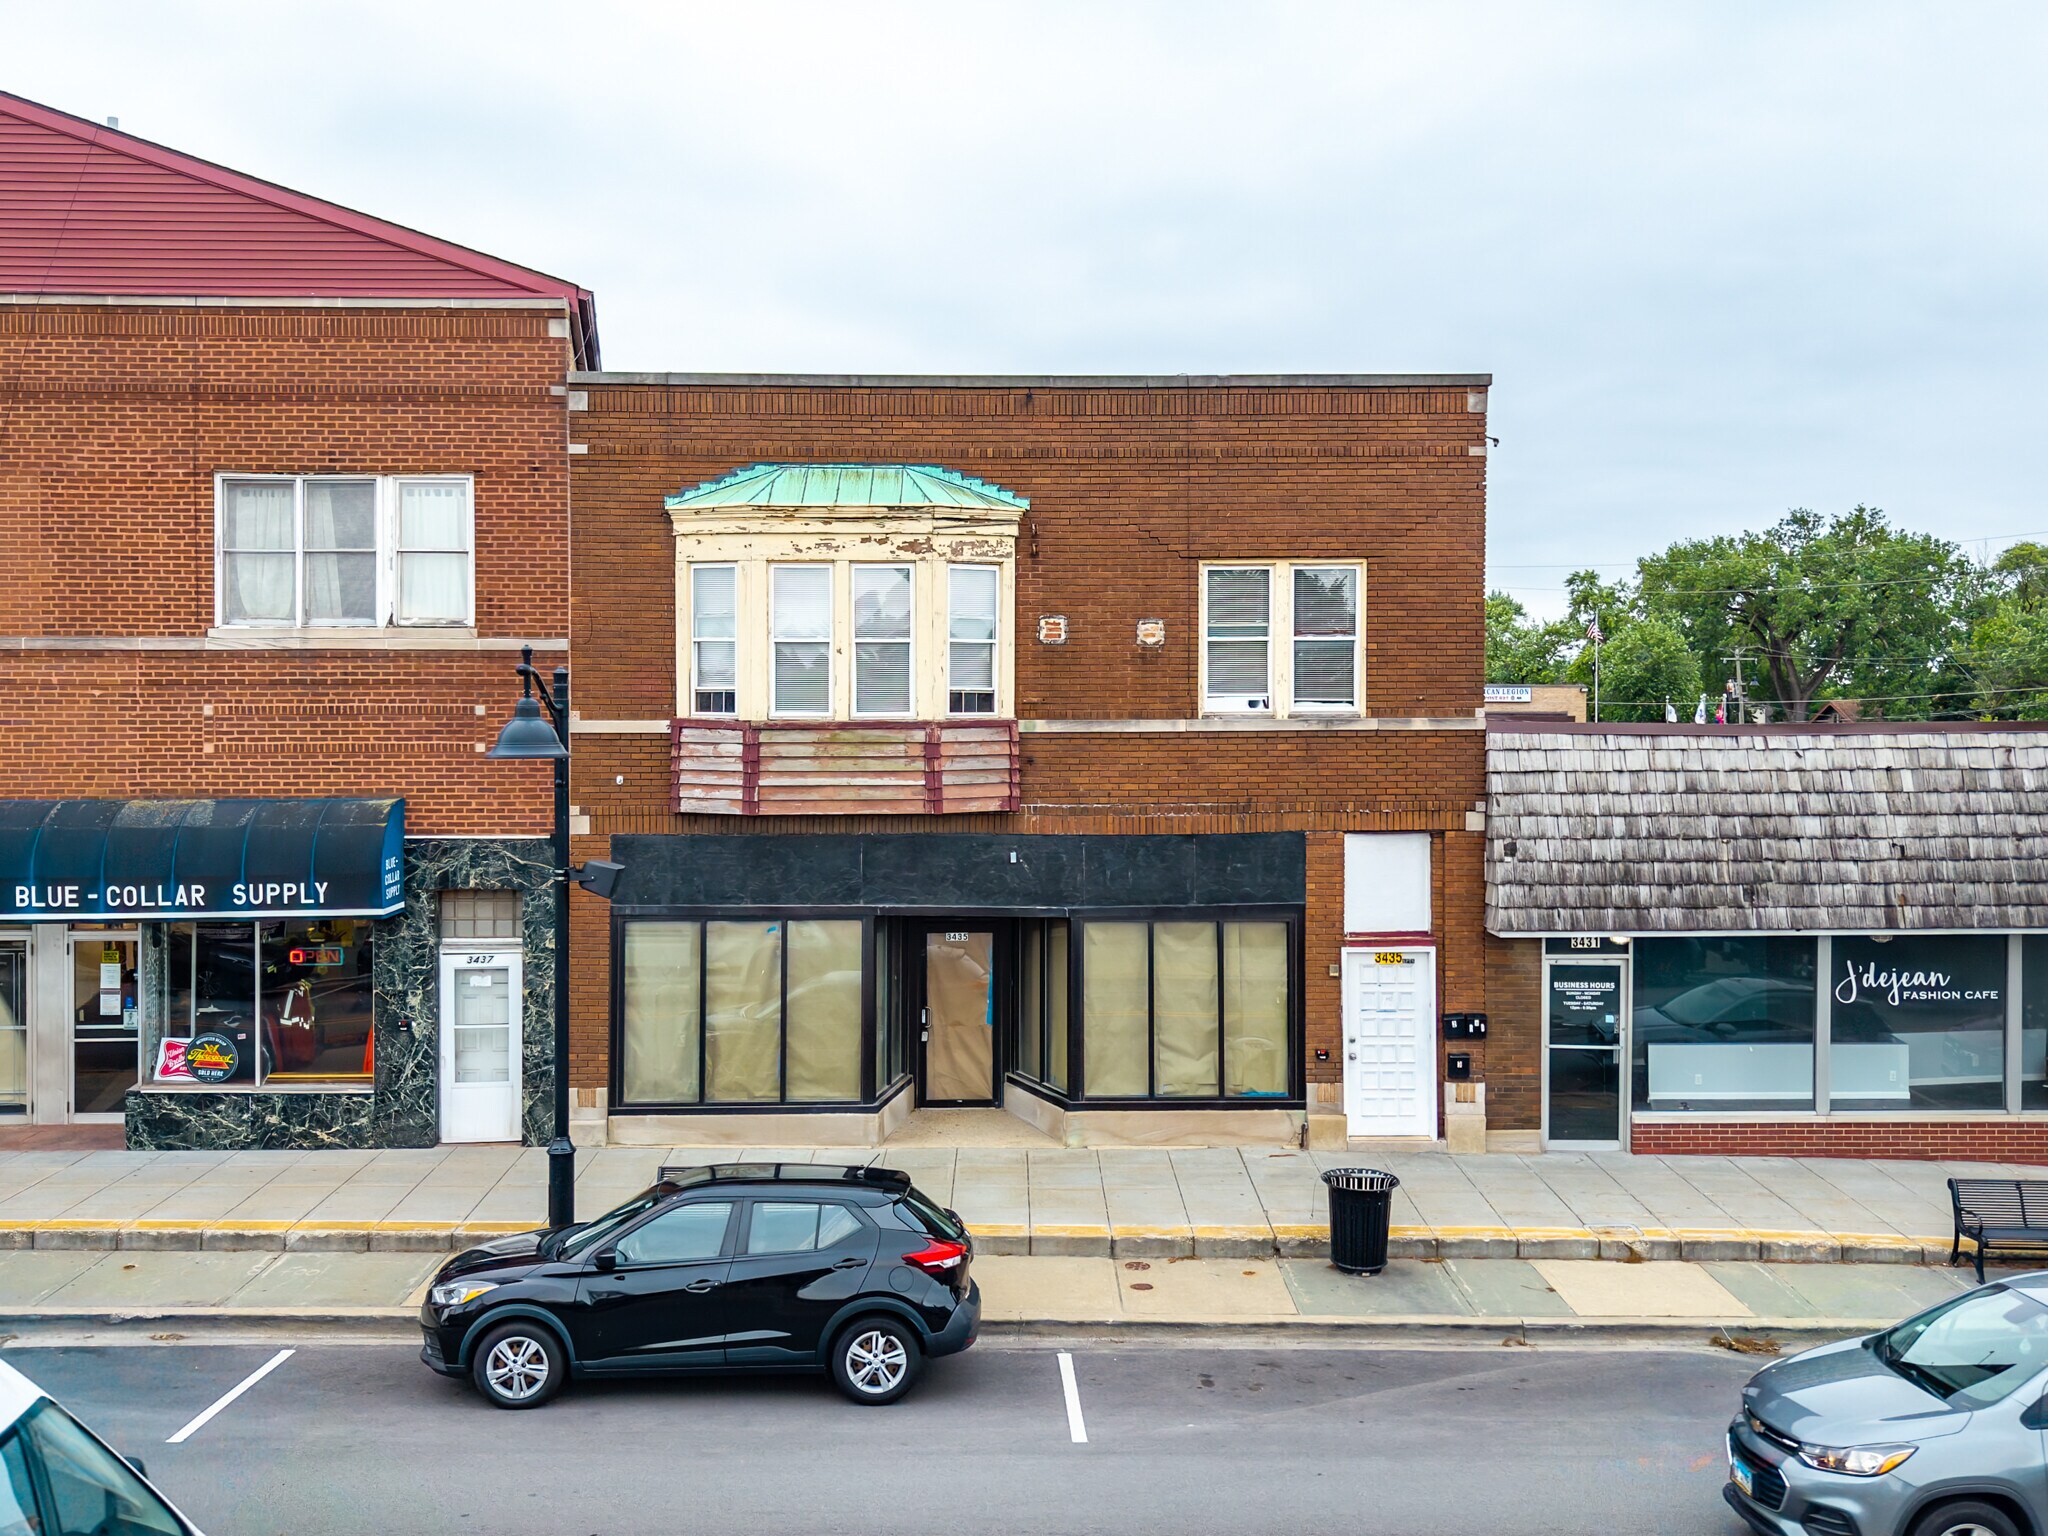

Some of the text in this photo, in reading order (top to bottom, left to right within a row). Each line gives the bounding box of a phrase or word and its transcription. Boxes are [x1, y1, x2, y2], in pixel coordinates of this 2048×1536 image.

[384, 870, 400, 885] COLLAR
[232, 881, 329, 906] SUPPLY
[385, 884, 401, 900] SUPPLY
[946, 933, 968, 941] 3435
[1572, 937, 1599, 948] 3431
[290, 949, 340, 964] OPEN
[466, 955, 494, 964] 3437
[1375, 952, 1402, 963] 3435
[1903, 990, 1999, 1000] FASHION CAFE
